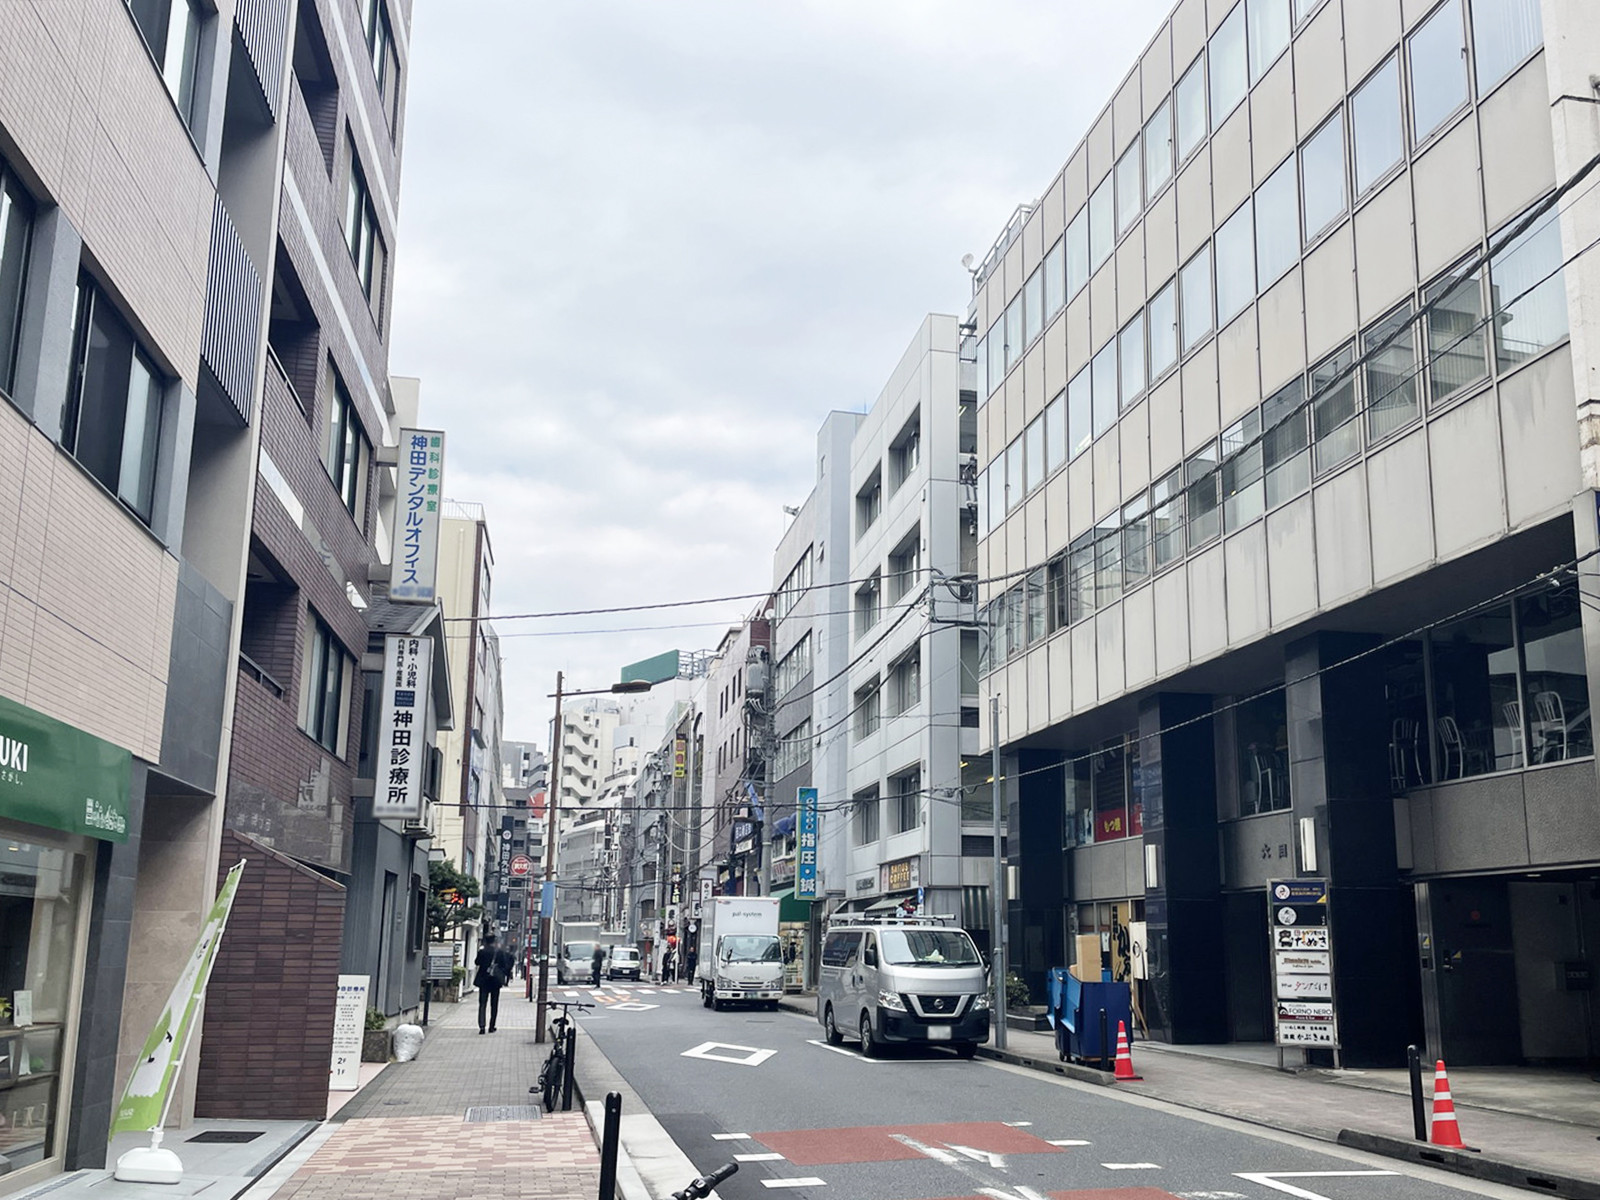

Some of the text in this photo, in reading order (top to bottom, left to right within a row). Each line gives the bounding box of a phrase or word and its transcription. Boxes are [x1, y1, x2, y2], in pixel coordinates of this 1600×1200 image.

[402, 435, 428, 584] 神田デンタルオフィス
[426, 436, 441, 512] 歯科診療室
[406, 639, 419, 688] 内科・小児科
[387, 710, 413, 804] 神田診療所
[890, 871, 910, 884] COFFEE
